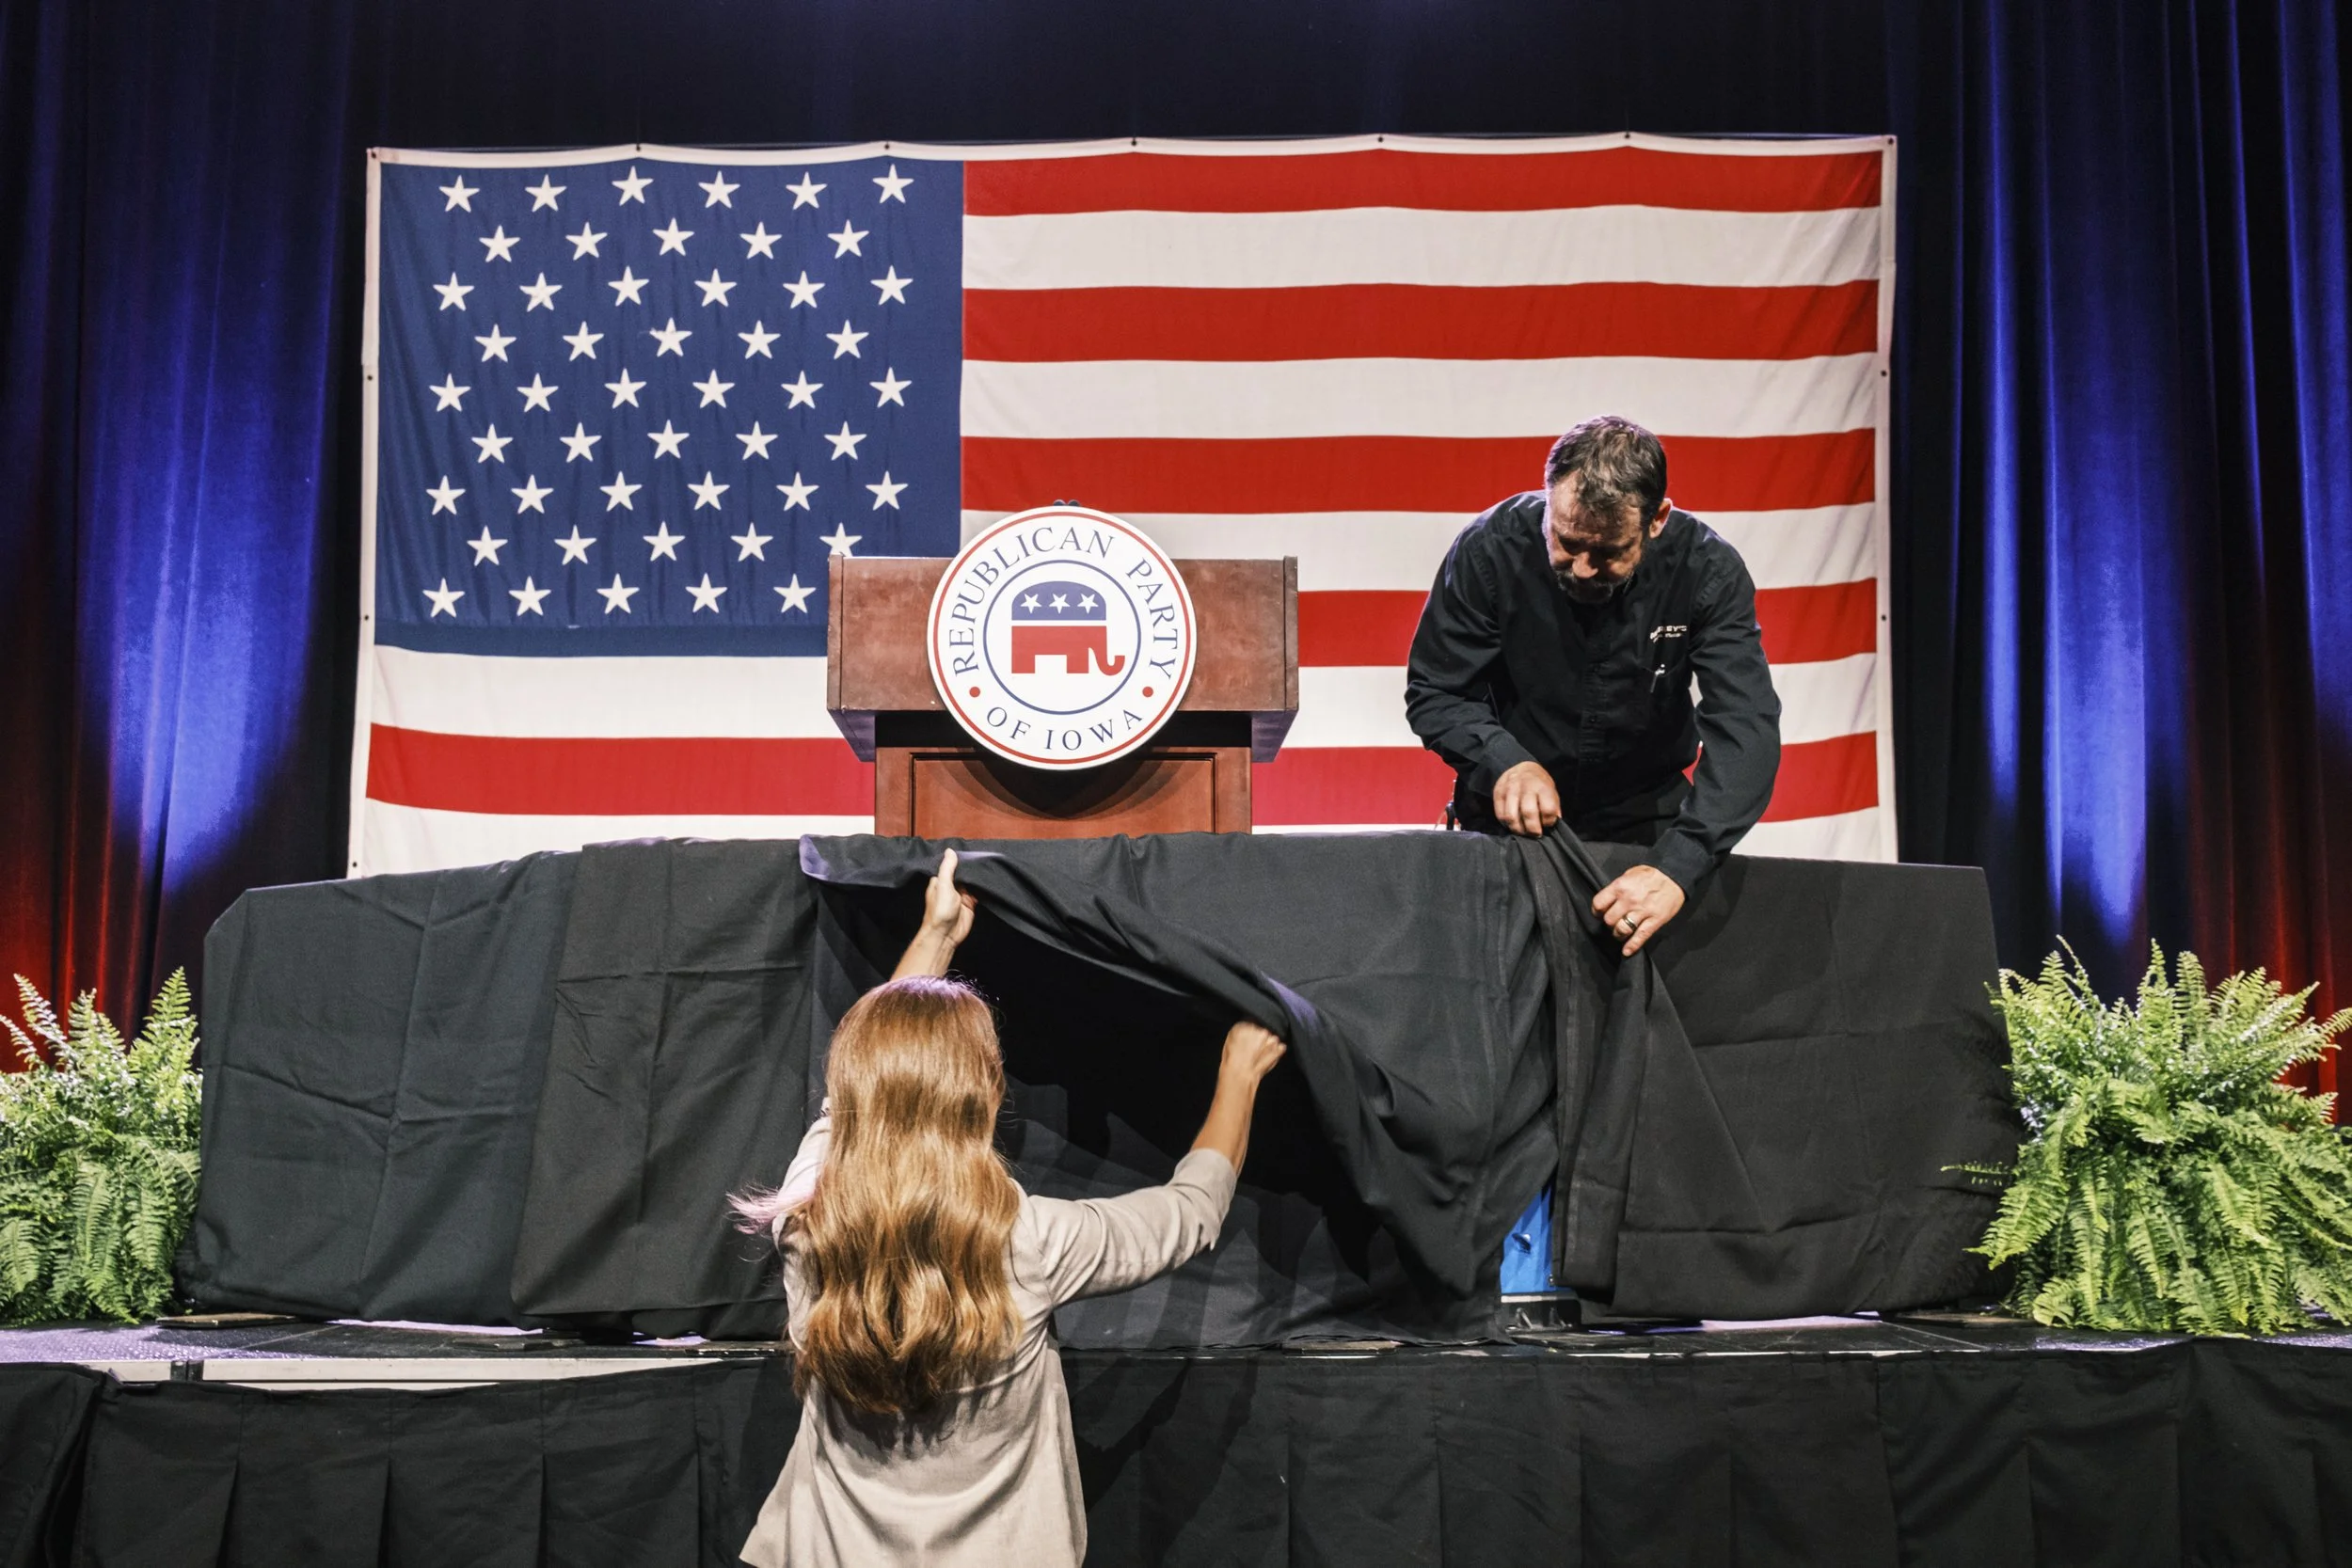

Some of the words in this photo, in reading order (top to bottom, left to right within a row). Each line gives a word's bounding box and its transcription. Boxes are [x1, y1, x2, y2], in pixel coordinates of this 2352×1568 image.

[949, 527, 1114, 676] REPUBLICAN
[1126, 558, 1178, 679] PARTY
[987, 706, 1031, 740] OF
[1045, 708, 1142, 751] IOWA
